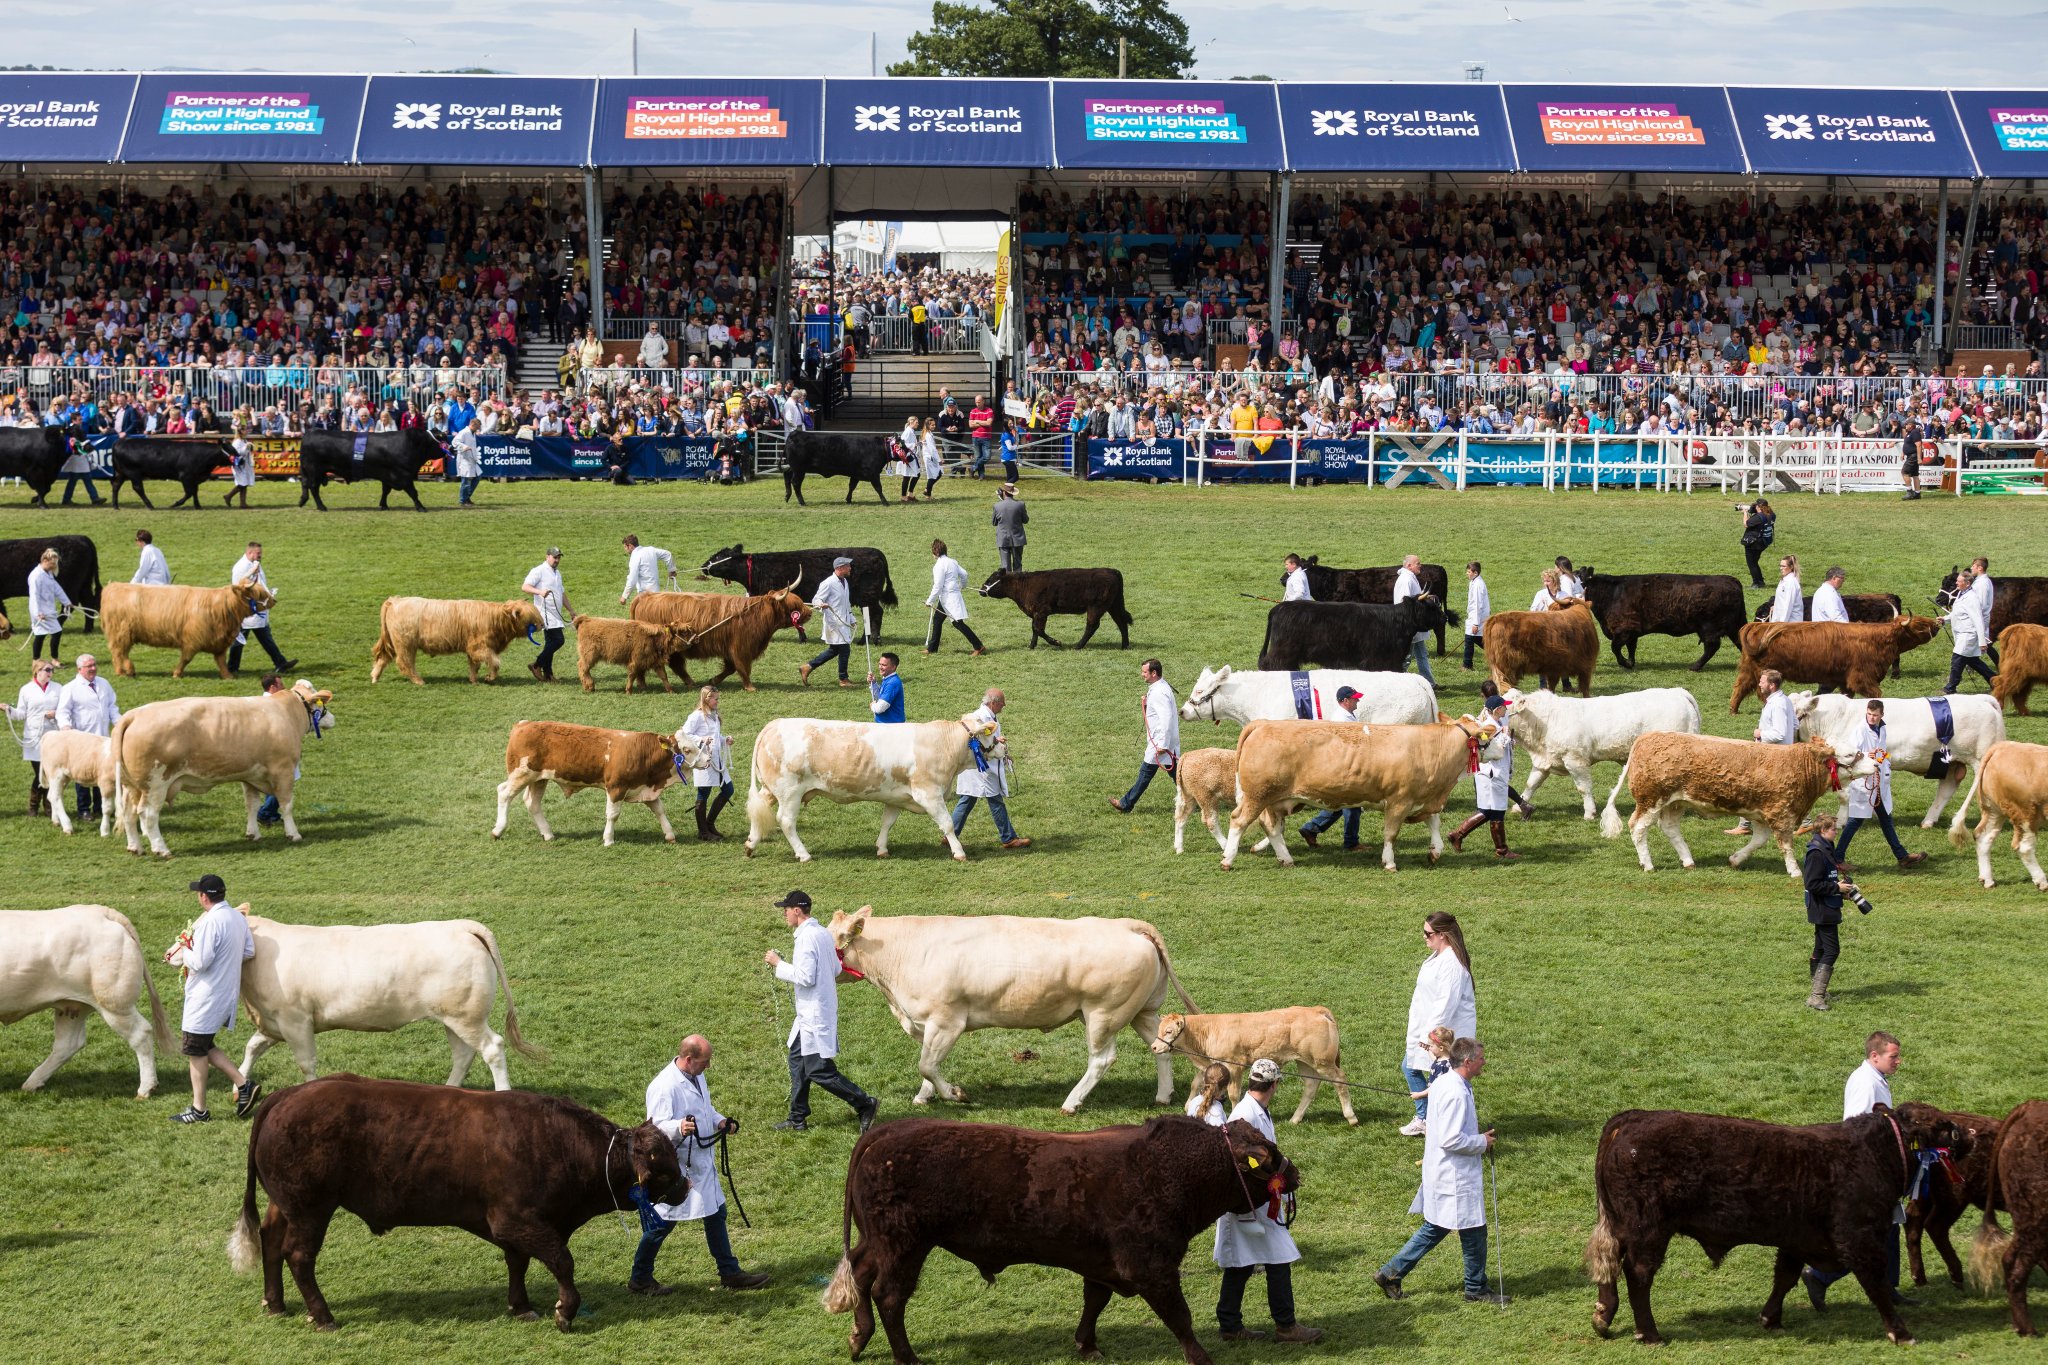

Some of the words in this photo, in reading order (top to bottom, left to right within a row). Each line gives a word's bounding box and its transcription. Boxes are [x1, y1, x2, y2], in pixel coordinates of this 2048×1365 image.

[50, 101, 99, 113] Bank
[174, 95, 247, 106] Partner
[248, 96, 269, 106] of
[269, 96, 301, 107] the
[636, 100, 707, 110] Partner
[709, 100, 729, 110] of
[729, 100, 760, 110] the
[171, 108, 223, 120] Royal
[226, 108, 310, 120] Highland
[449, 103, 506, 118] Royal
[511, 104, 563, 117] Bank
[908, 106, 964, 120] Royal
[970, 107, 1021, 118] Bank
[1092, 103, 1163, 113] Partner
[1166, 104, 1186, 114] of
[1186, 104, 1217, 114] the
[1546, 106, 1617, 116] Partner
[1619, 107, 1639, 117] of
[1639, 107, 1670, 117] the
[7, 115, 98, 127] Scotland
[634, 113, 685, 125] Royal
[687, 113, 770, 124] Highland
[1093, 115, 1145, 127] Royal
[1147, 116, 1229, 128] Highland
[1363, 110, 1418, 124] Royal
[1425, 111, 1476, 122] Bank
[1817, 115, 1872, 129] Royal
[1877, 116, 1931, 128] Bank
[168, 121, 222, 131] Show
[224, 121, 272, 131] since
[274, 121, 316, 131] 1981
[446, 118, 470, 130] of
[473, 118, 562, 130] Scotland
[908, 120, 931, 131] of
[934, 121, 1022, 132] Scotland
[1366, 124, 1389, 136] of
[1392, 125, 1480, 136] Scotland
[1549, 120, 1600, 131] Royal
[1602, 120, 1684, 131] Highland
[633, 126, 686, 136] Show
[688, 125, 737, 136] since
[739, 126, 780, 135] 1981
[1094, 128, 1146, 138] Show
[1150, 129, 1196, 139] since
[1199, 129, 1240, 140] 1981
[1822, 129, 1844, 140] of
[1849, 130, 1936, 142] Scotland
[2001, 124, 2048, 138] Roya
[1551, 132, 1604, 142] Show
[1607, 132, 1654, 142] since
[1657, 132, 1698, 142] 1981
[997, 255, 1009, 305] savills
[484, 446, 508, 456] Royal
[509, 446, 531, 455] Bank
[574, 449, 604, 457] Partner
[1125, 446, 1148, 457] Royal
[1150, 447, 1172, 455] Bank
[1324, 453, 1362, 461] HIGHLAND
[484, 457, 494, 465] of
[495, 456, 532, 465] Scotland
[1125, 457, 1135, 465] of
[1136, 457, 1172, 466] Scotland
[1846, 455, 1899, 464] TRANSPORT
[1481, 456, 1572, 479] Edinbugh
